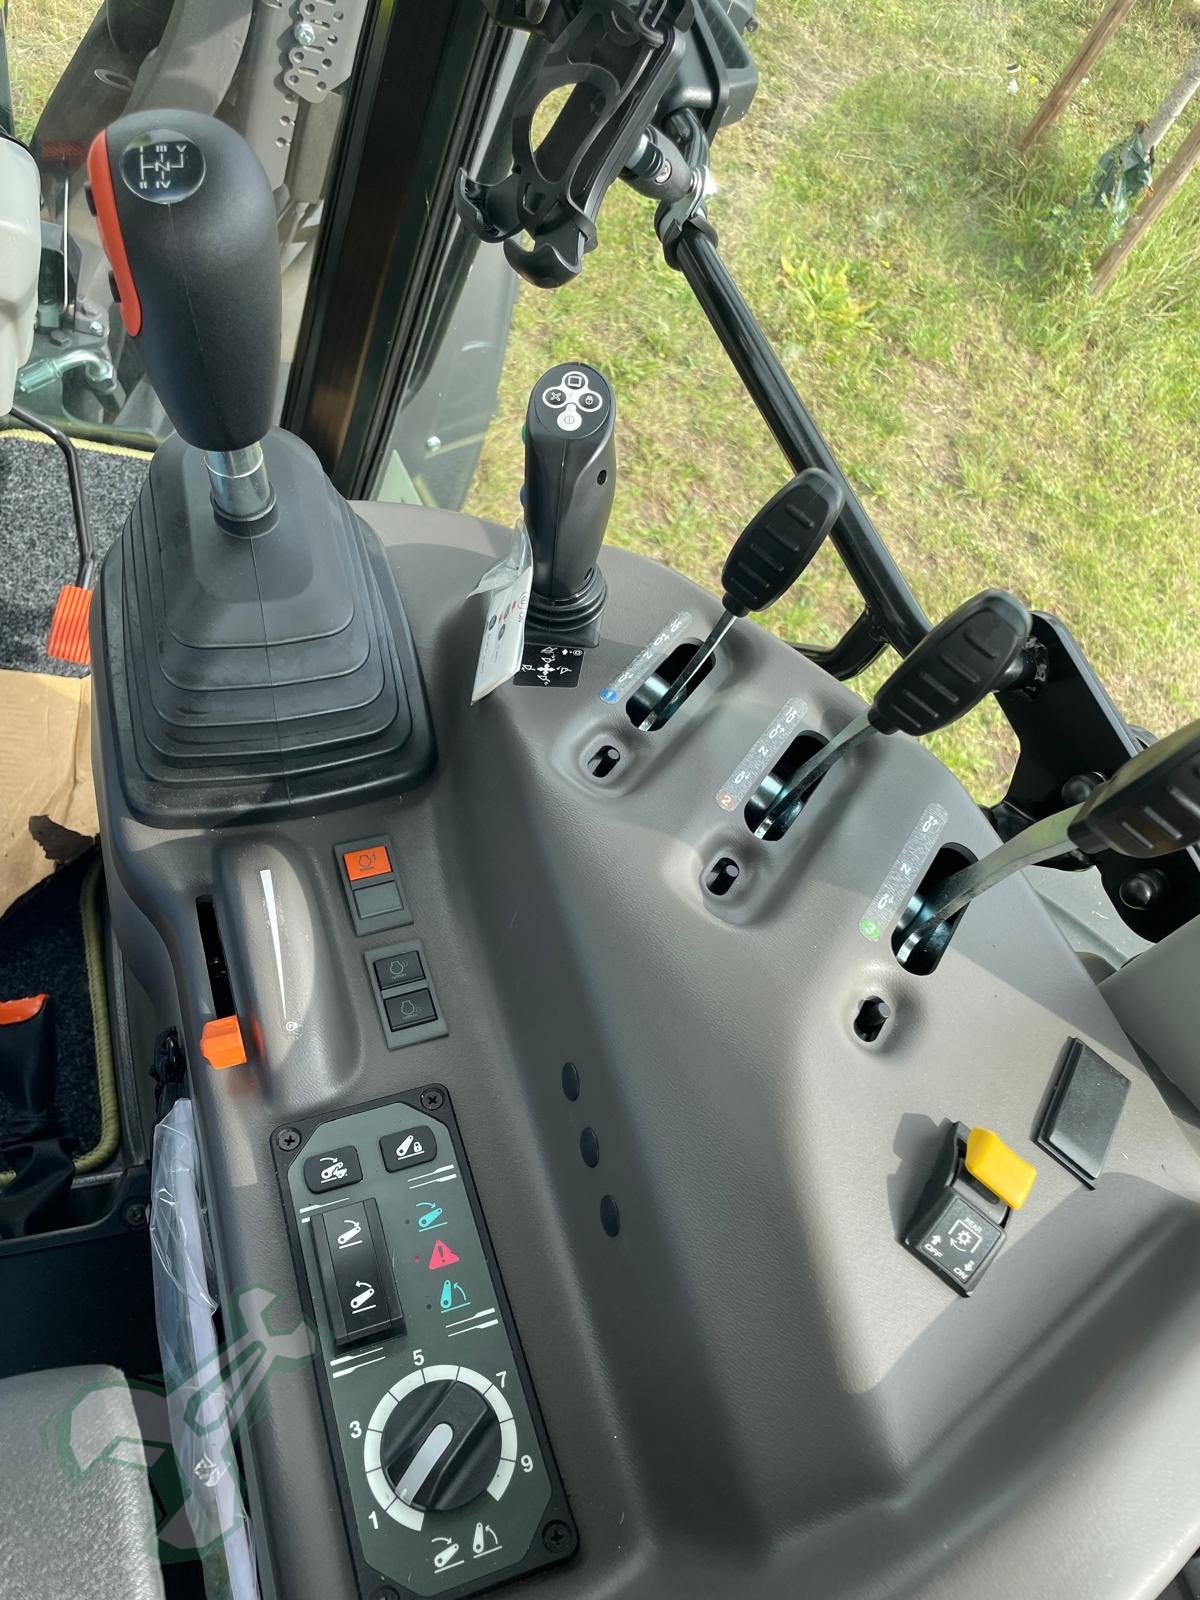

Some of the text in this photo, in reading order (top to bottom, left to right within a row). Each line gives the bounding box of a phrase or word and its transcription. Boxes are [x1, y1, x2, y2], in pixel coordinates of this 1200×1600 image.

[155, 145, 168, 153] III
[155, 161, 170, 172] N
[139, 180, 171, 190] II IV
[758, 746, 769, 756] N
[720, 795, 731, 806] 2
[900, 863, 911, 875] N
[864, 923, 875, 934] 3
[964, 1217, 983, 1233] REAR
[924, 1243, 944, 1258] OFF
[953, 1267, 969, 1281] ON
[412, 1348, 425, 1366] 5
[495, 1370, 507, 1389] 7
[349, 1420, 362, 1439] 3
[520, 1455, 534, 1473] 9
[368, 1510, 379, 1530] 1
